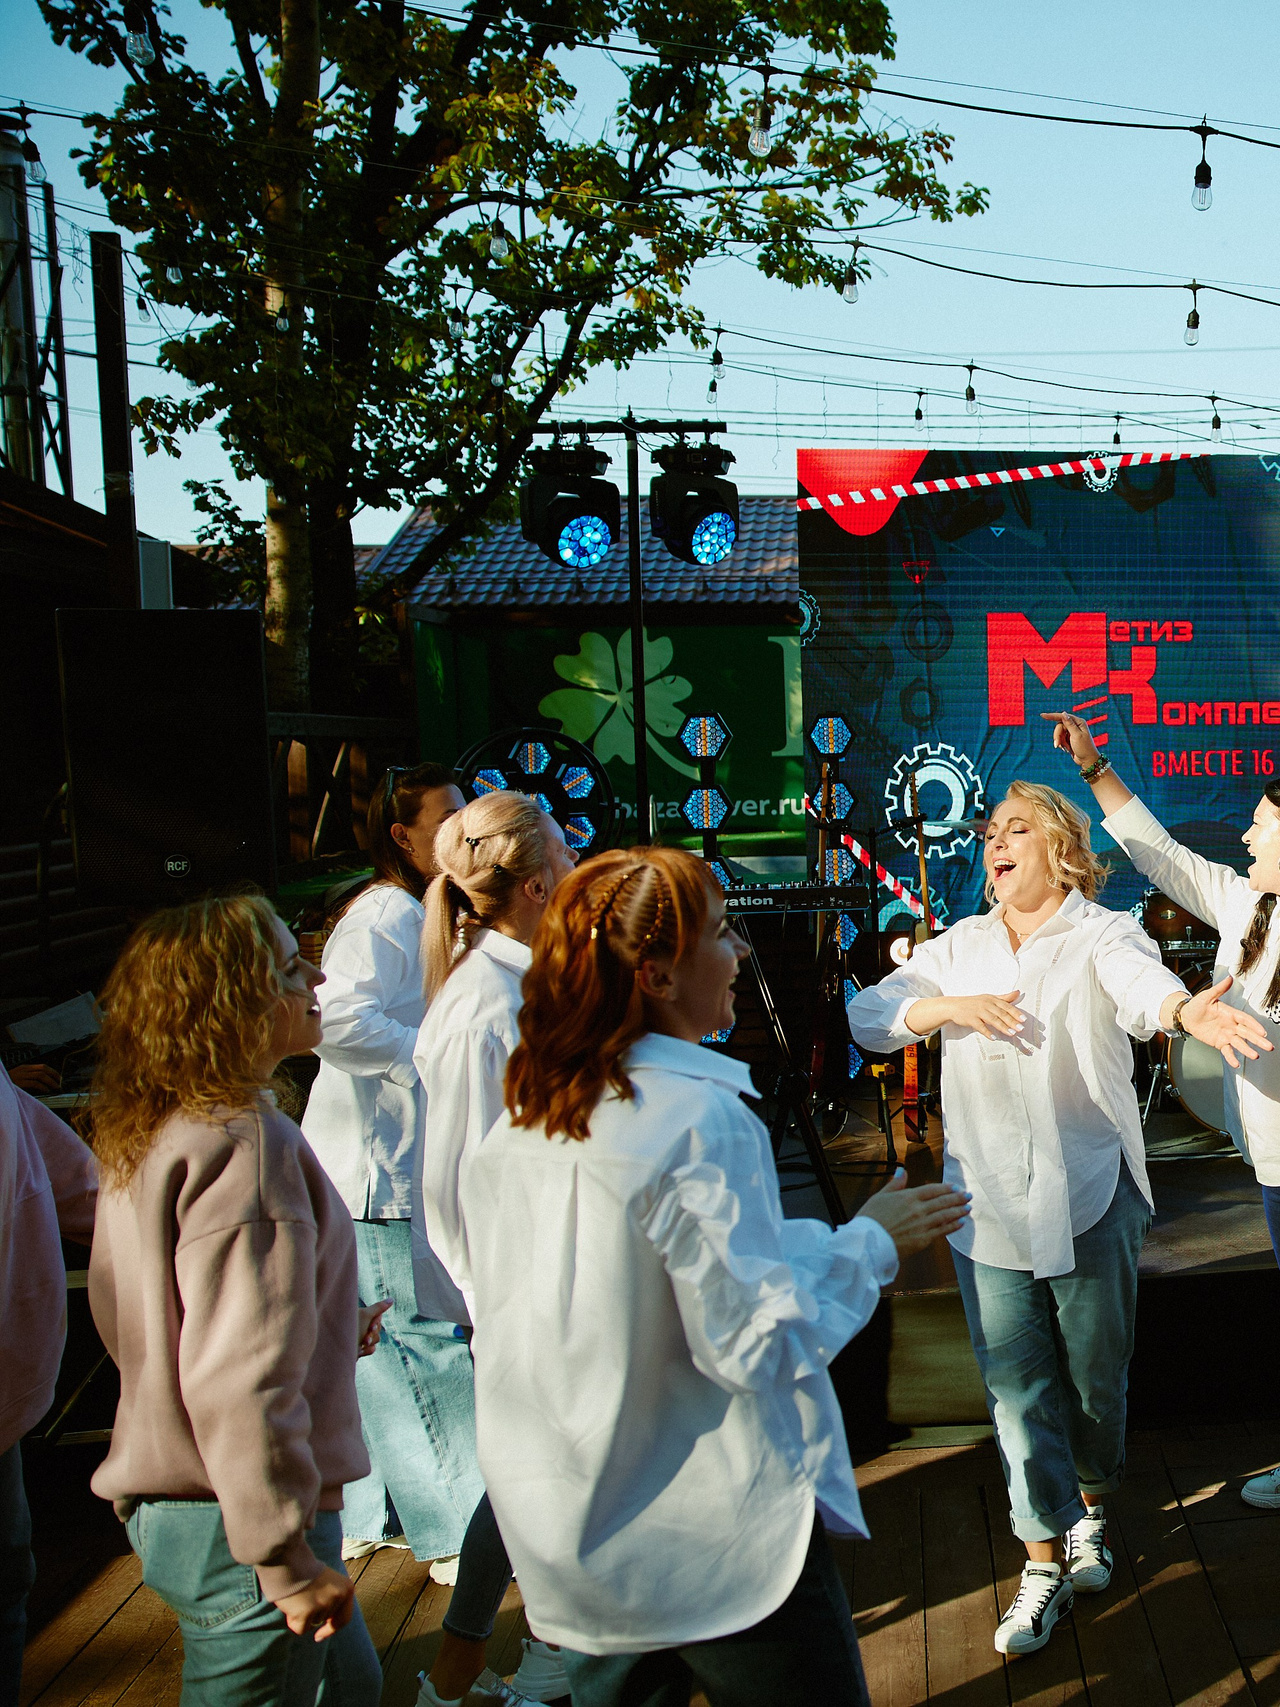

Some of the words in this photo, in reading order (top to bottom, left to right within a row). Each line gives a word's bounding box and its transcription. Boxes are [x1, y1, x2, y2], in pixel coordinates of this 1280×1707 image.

[1152, 750, 1244, 777] ВМЕСТЕ
[1251, 750, 1275, 776] 16
[166, 861, 188, 871] RCF
